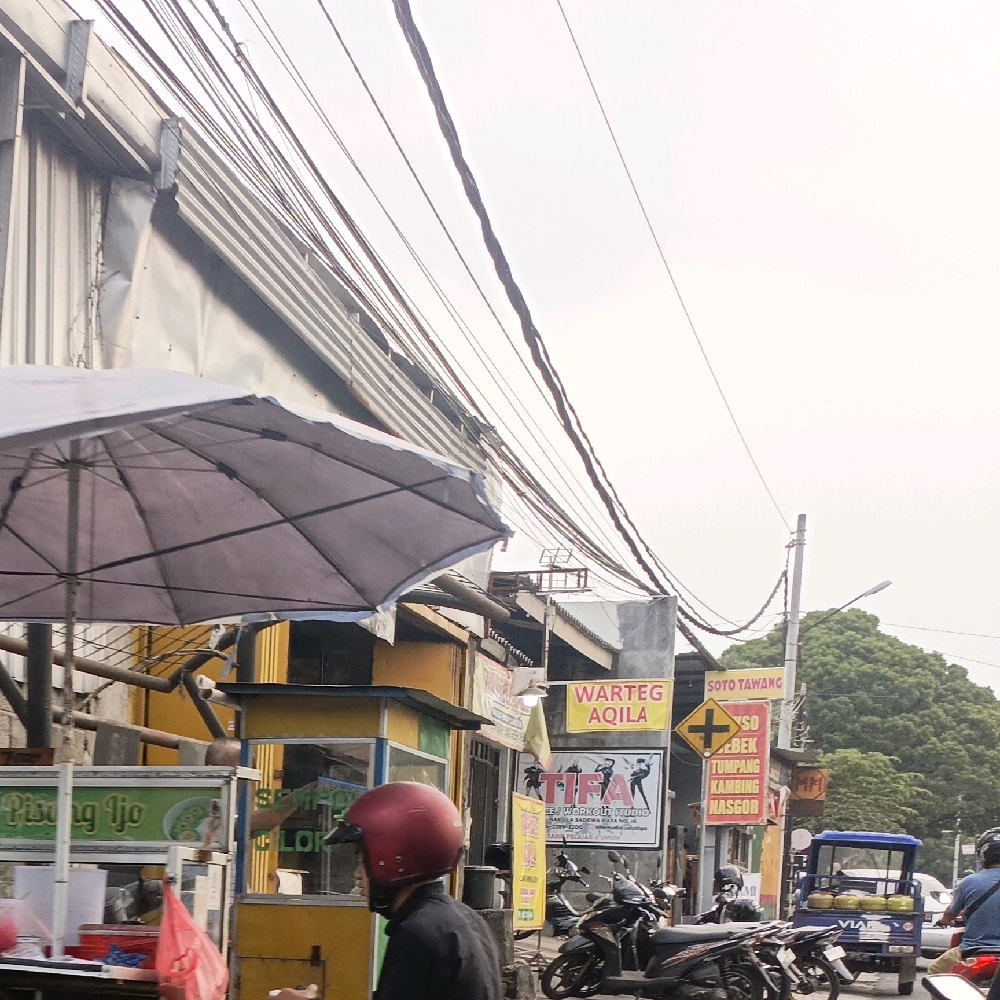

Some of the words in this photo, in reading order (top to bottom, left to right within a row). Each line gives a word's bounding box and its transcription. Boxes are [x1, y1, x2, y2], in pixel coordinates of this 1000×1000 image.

[707, 679, 736, 692] SOTO
[737, 676, 783, 691] TAWANG
[575, 684, 664, 703] WARTEG
[588, 706, 648, 725] AQILA
[711, 759, 760, 774] TUMPANG
[540, 773, 634, 805] TIFA
[710, 780, 760, 795] KAMBING
[103, 791, 147, 835] Ijo
[563, 806, 613, 816] WORKOUT
[614, 807, 651, 818] STUDIO
[709, 799, 759, 815] NASGOR
